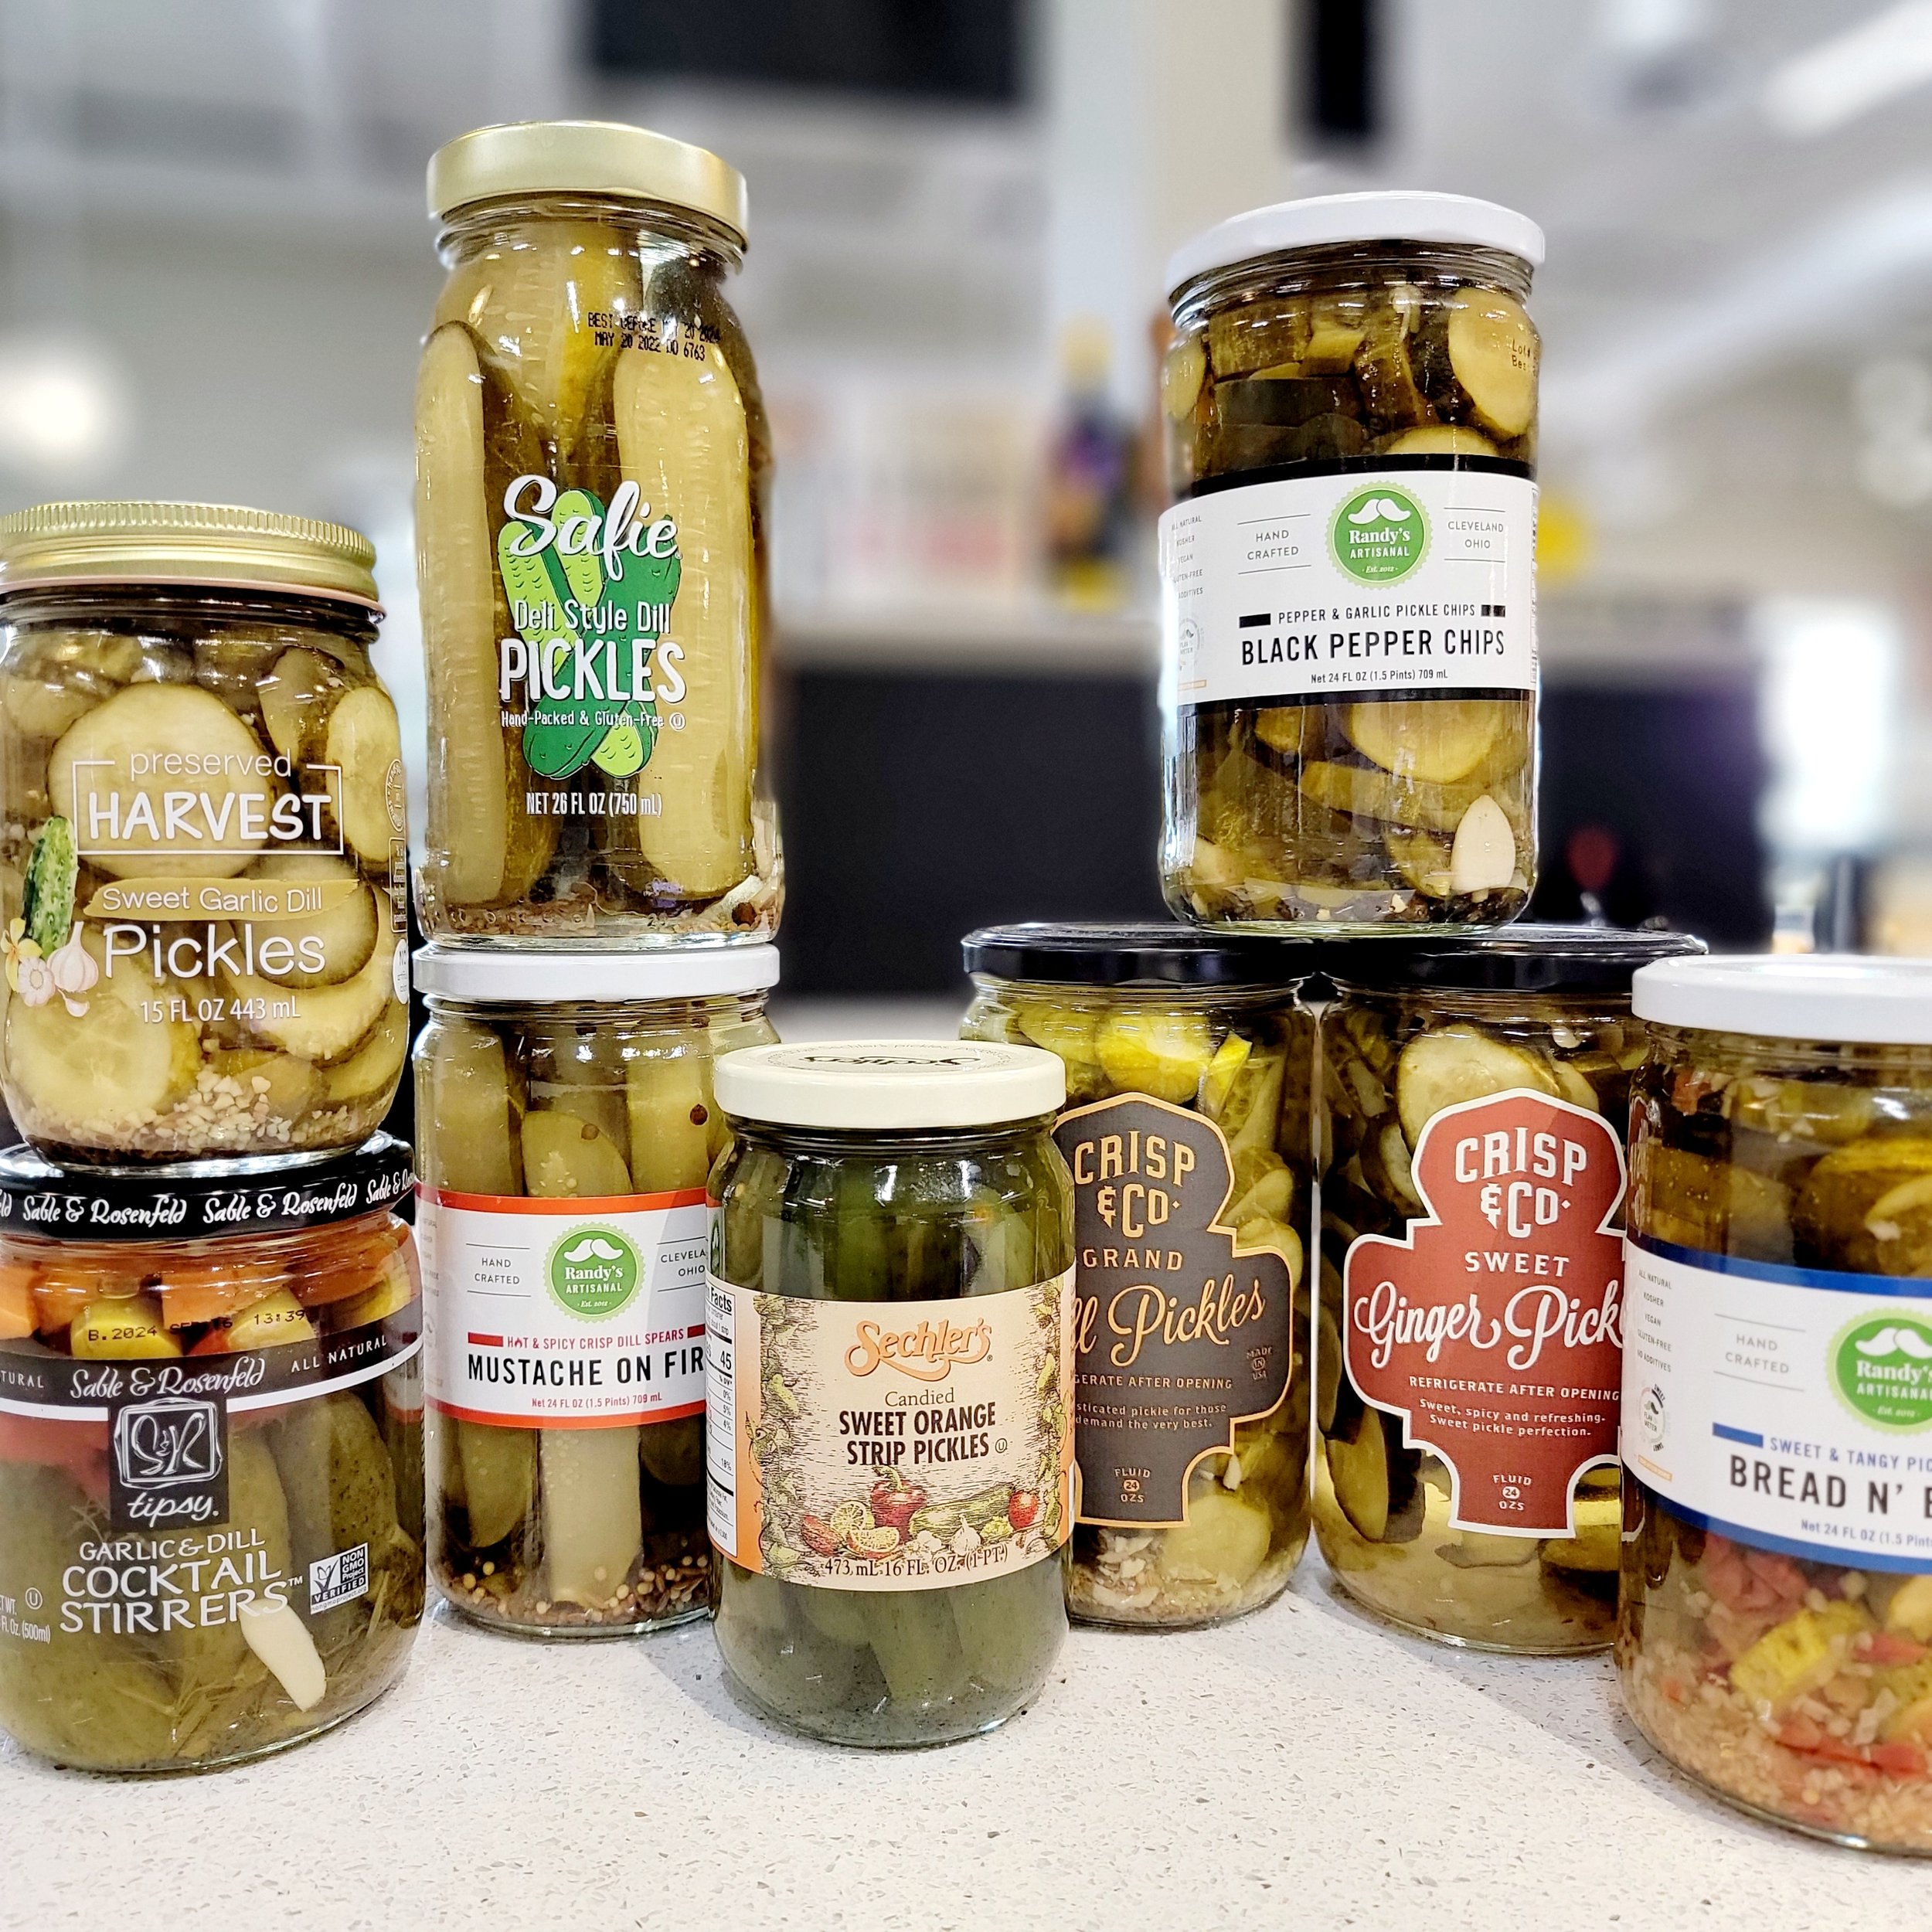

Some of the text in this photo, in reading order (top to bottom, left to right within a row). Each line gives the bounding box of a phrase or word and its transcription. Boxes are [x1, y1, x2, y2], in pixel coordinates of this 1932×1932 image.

[588, 312, 613, 328] BEST
[595, 332, 614, 346] MAY
[504, 474, 679, 581] Safie
[1255, 529, 1290, 543] HAND
[1447, 520, 1505, 533] CLEVELAND
[1349, 527, 1410, 547] Randy's
[1464, 538, 1491, 549] OHIO
[1247, 546, 1299, 560] CRAFTED
[1350, 545, 1410, 559] ARTISANAL
[515, 599, 671, 634] Deli Style Dill
[1278, 604, 1475, 624] PEPPER & GARLIC PICKLE CHIPS
[1241, 629, 1505, 665] BLACK PEPPER CHIPS
[501, 638, 686, 702] PICKLES
[1311, 668, 1447, 684] Net 24 FL OZ (1.5 Pints) 709 mL
[501, 710, 664, 727] Hand-Packed & Gluten-Free
[130, 749, 291, 779] preserved
[526, 792, 662, 818] NET 26 FL OZ (750 mL)
[89, 791, 332, 841] HARVEST
[103, 887, 322, 913] Sweet Garlic Dill
[104, 924, 325, 978] Pickles
[141, 995, 300, 1022] 15 FL OZ 443 mL
[1074, 1130, 1195, 1187] CRISP
[1454, 1126, 1587, 1187] CRISP
[22, 1196, 60, 1222] Sable
[65, 1196, 84, 1220] &
[90, 1199, 186, 1227] Rosenfeld
[202, 1196, 251, 1223] Sable
[257, 1193, 277, 1217] &
[281, 1184, 358, 1216] Rosenfeld
[481, 1258, 512, 1268] HAND
[661, 1250, 706, 1263] CLEVELA
[1083, 1249, 1182, 1271] GRAND
[1464, 1252, 1570, 1277] SWEET
[474, 1274, 520, 1284] CRAFTED
[564, 1265, 624, 1281] Randy's
[679, 1265, 705, 1277] OHIO
[566, 1283, 623, 1294] ARTISANAL
[1648, 1274, 1672, 1289] NATURAL
[711, 1286, 732, 1312] Facts
[1644, 1292, 1663, 1307] KOSHER
[1107, 1274, 1266, 1368] Pickles
[1354, 1280, 1624, 1370] Ginger Pick
[1645, 1313, 1661, 1326] VEGAN
[88, 1325, 158, 1342] B.2024
[532, 1338, 539, 1349] &
[543, 1338, 575, 1349] SPICY
[580, 1337, 613, 1349] CRISP
[617, 1335, 641, 1346] DILL
[645, 1329, 684, 1345] SPEARS
[1638, 1329, 1672, 1352] GLUTEN-FREE
[1736, 1333, 1777, 1351] HAND
[291, 1335, 387, 1373] ALL NATURAL
[844, 1317, 992, 1382] Sechler's
[468, 1354, 603, 1386] MUSTACHE
[617, 1355, 651, 1384] ON
[665, 1346, 704, 1379] FIR
[720, 1350, 731, 1370] 45
[1644, 1352, 1671, 1372] ADDITIVES
[1725, 1352, 1789, 1374] CRAFTED
[70, 1357, 266, 1397] Sable & Rosenfeld
[1128, 1376, 1232, 1389] AFTER OPENING
[885, 1387, 955, 1406] Candied
[1409, 1376, 1619, 1402] REFRIGERATE AFTER OPENING
[532, 1398, 544, 1407] Net
[548, 1399, 557, 1407] 24
[573, 1398, 583, 1407] OZ
[586, 1398, 602, 1408] (1.5
[605, 1396, 630, 1407] Pints)
[633, 1394, 648, 1405] 709
[650, 1393, 662, 1402] mL
[1131, 1404, 1226, 1417] pickle for those
[839, 1402, 995, 1436] SWEET ORANGE
[1419, 1399, 1606, 1424] Sweet, spicy and refreshing.
[1076, 1416, 1212, 1430] demand the very best.
[1430, 1414, 1590, 1437] Sweet pickle perfection.
[847, 1432, 989, 1465] STRIP PICKLES
[1770, 1437, 1899, 1470] SWEET & TANGY
[1114, 1468, 1151, 1478] FLUID
[1493, 1475, 1532, 1486] FLUID
[1125, 1481, 1137, 1490] 24
[1505, 1488, 1519, 1498] 24
[1730, 1454, 1847, 1509] BREAD
[1868, 1481, 1903, 1514] N'
[1121, 1495, 1145, 1503] OZS
[1498, 1500, 1525, 1511] OZS
[1801, 1519, 1902, 1546] Net 24 FL OZ (1.5
[342, 1549, 363, 1565] NON
[342, 1558, 364, 1573] GMO
[62, 1550, 281, 1598] COCKTAIL
[885, 1561, 902, 1576] 16
[314, 1577, 365, 1603] VERIFIED
[22, 1620, 50, 1645] (500ml)
